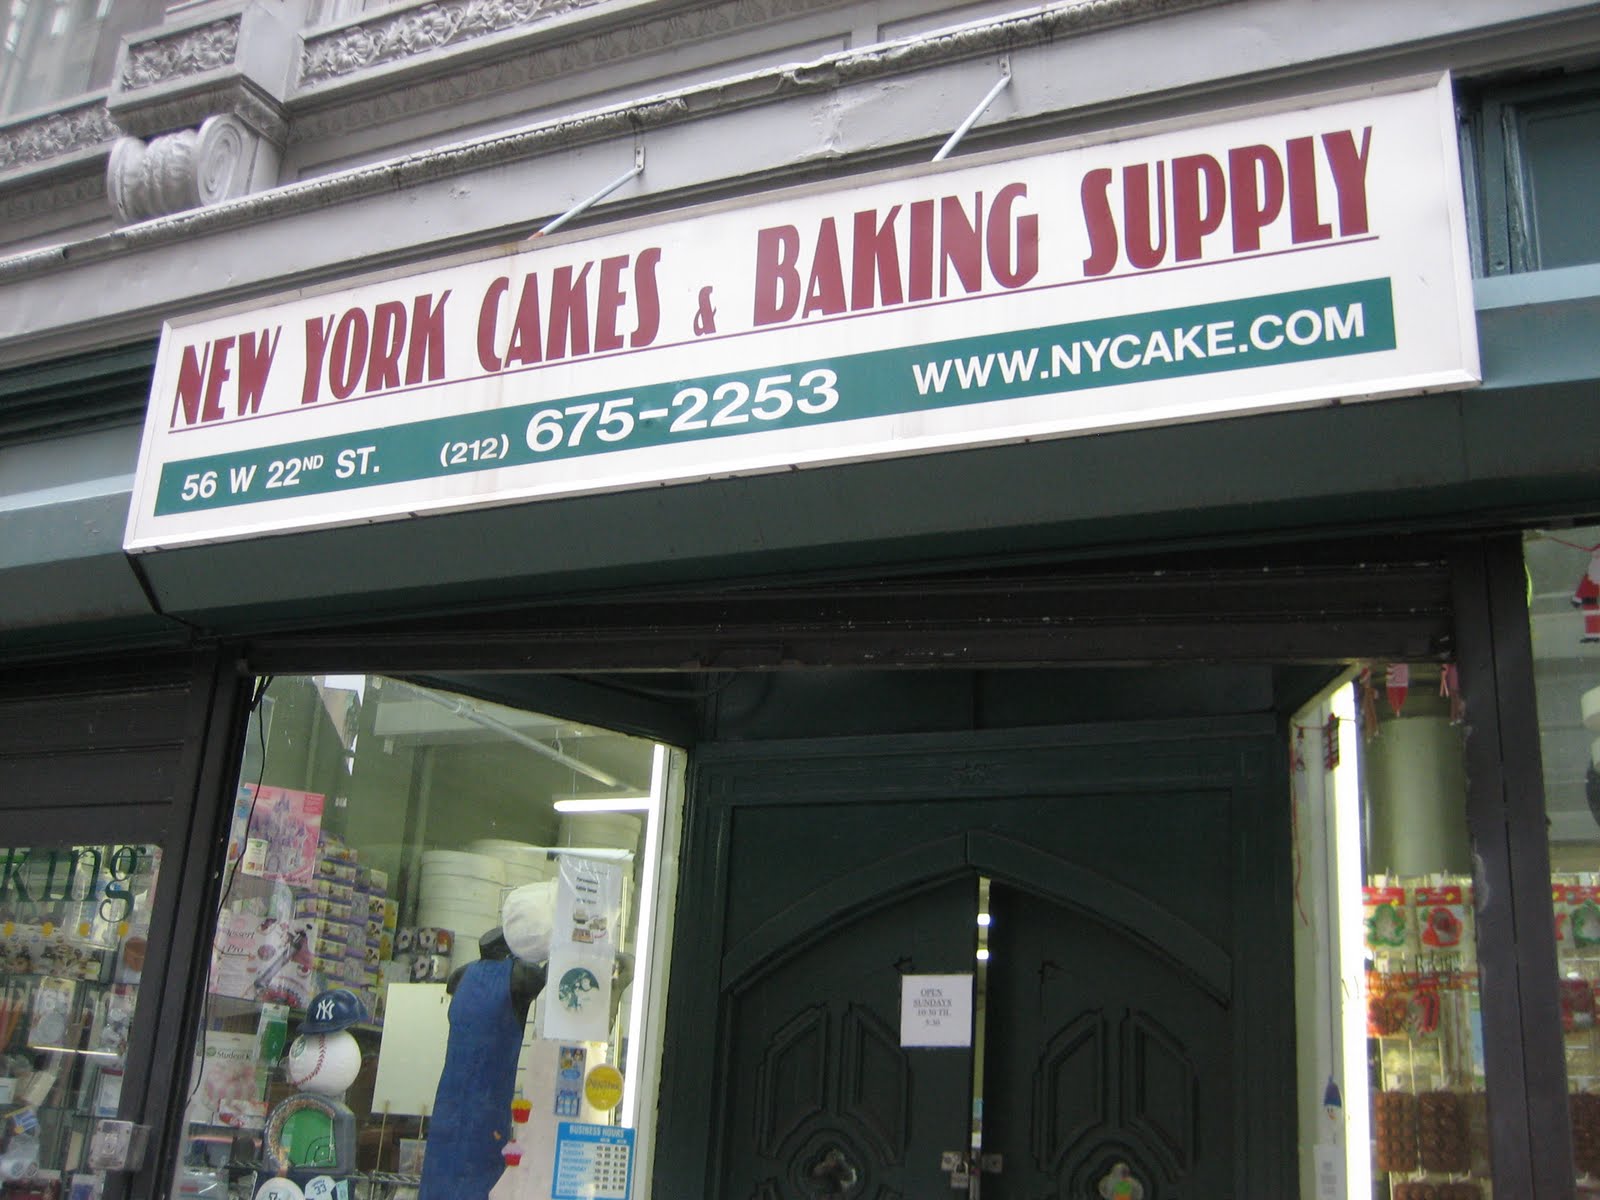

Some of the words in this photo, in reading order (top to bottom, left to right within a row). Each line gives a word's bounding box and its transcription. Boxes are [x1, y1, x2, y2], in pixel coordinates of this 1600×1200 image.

[170, 326, 281, 427] NEW
[302, 290, 452, 404] YORK
[477, 248, 661, 372] CAKES
[694, 286, 716, 336] &
[754, 183, 1038, 326] BAKING
[1081, 126, 1372, 276] SUPPLY
[911, 302, 1365, 395] WWW.NYCAKE.COM
[439, 434, 510, 468] (212)
[525, 368, 840, 453] 675-2253
[181, 471, 218, 501] 56
[230, 465, 258, 494] W
[265, 454, 324, 489] 22ND
[335, 446, 380, 478] ST.
[316, 999, 336, 1020] NY
[569, 1124, 601, 1136] BUSINESS
